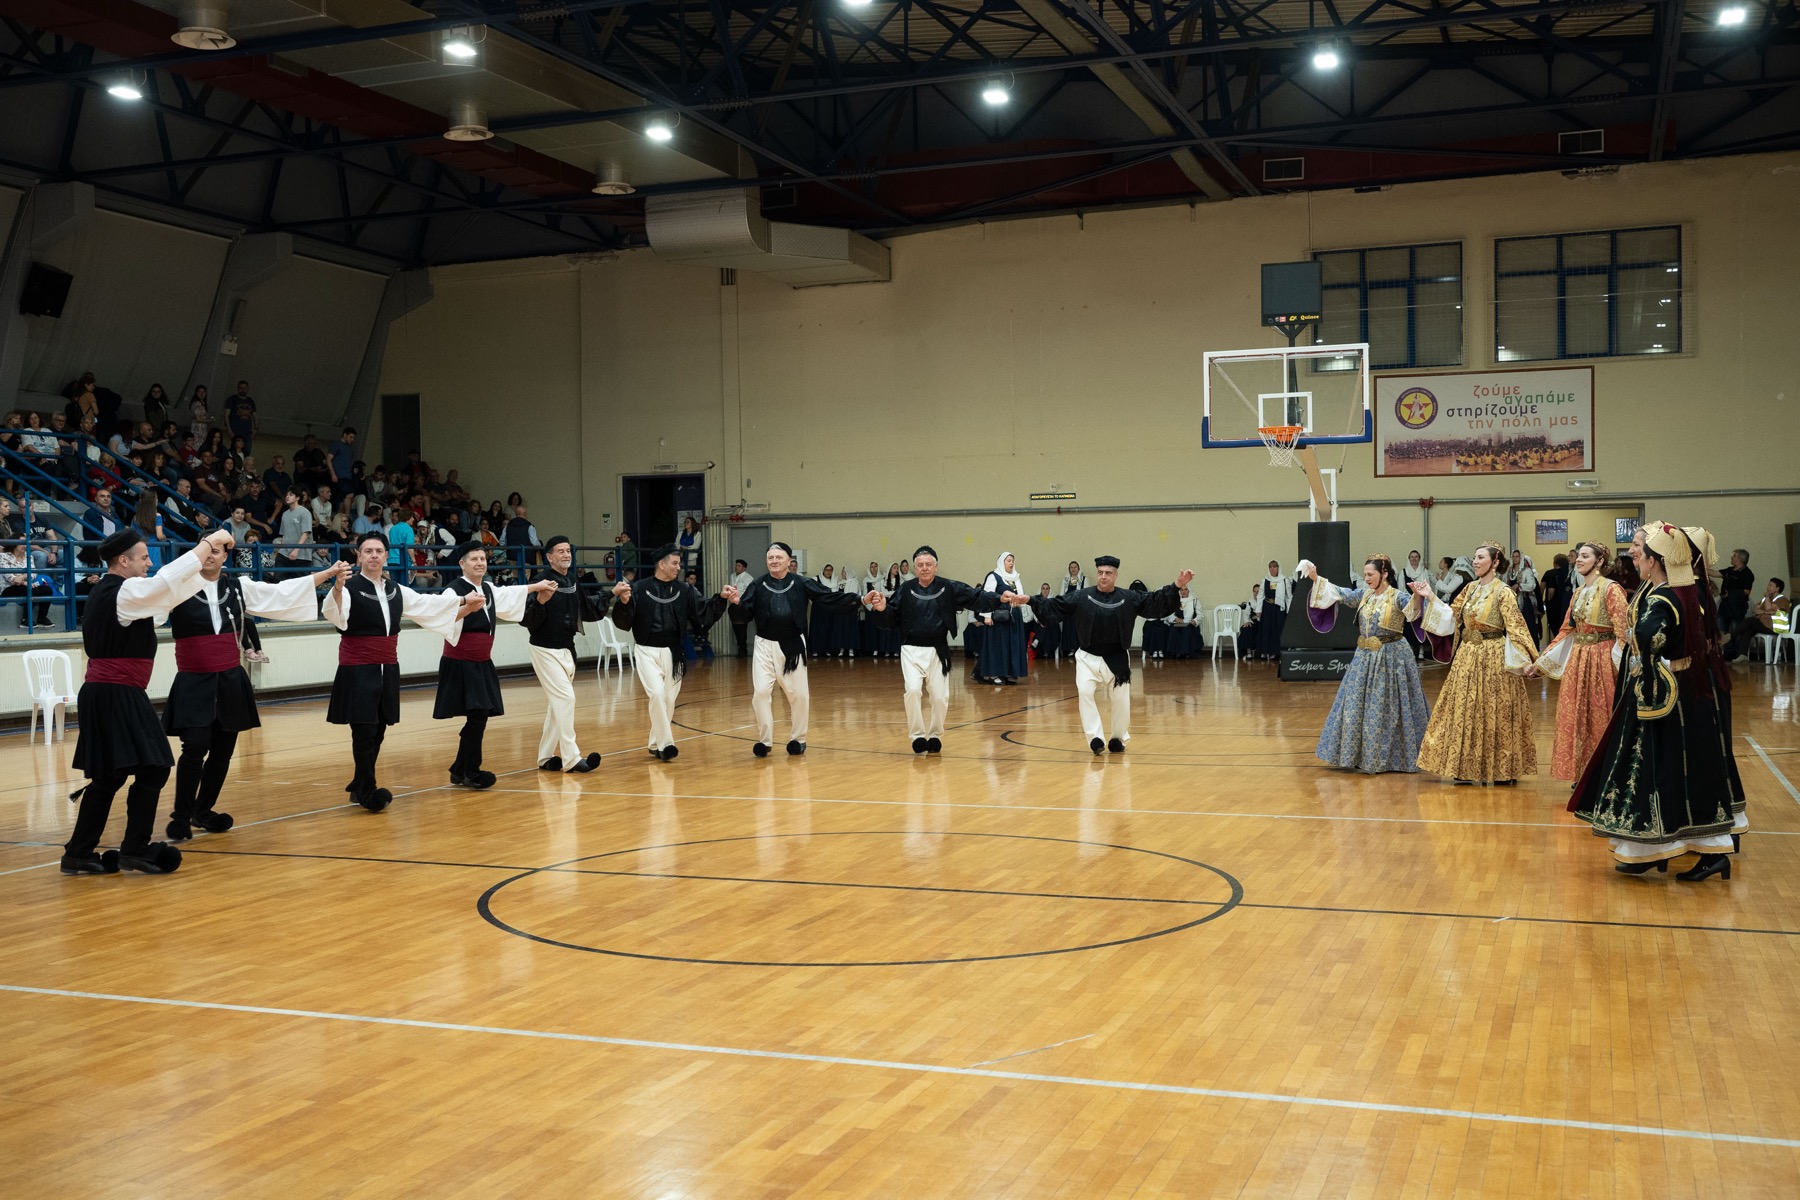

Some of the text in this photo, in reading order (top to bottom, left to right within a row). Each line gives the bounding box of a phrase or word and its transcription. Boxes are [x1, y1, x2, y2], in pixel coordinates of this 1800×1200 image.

[1473, 383, 1521, 399] ζούμε
[1504, 390, 1575, 406] αγαπάμε
[1446, 404, 1538, 418] στηρίζουμε
[1468, 415, 1578, 429] την πόλη μας
[1289, 659, 1350, 674] Super Spo
